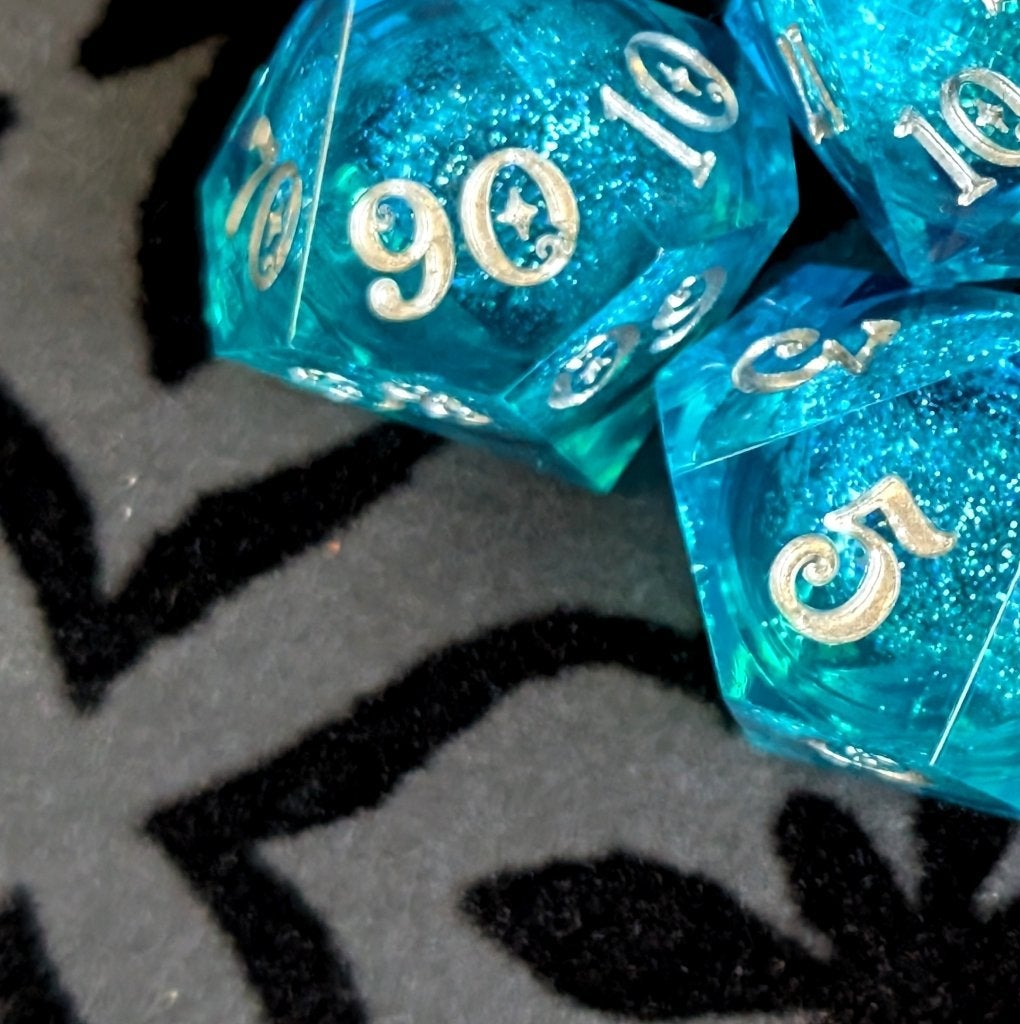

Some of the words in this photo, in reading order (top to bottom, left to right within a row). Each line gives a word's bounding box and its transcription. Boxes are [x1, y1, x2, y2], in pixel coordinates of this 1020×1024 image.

[601, 31, 739, 189] 10
[225, 115, 303, 292] 70
[349, 146, 581, 321] 90
[768, 475, 959, 646] 5
